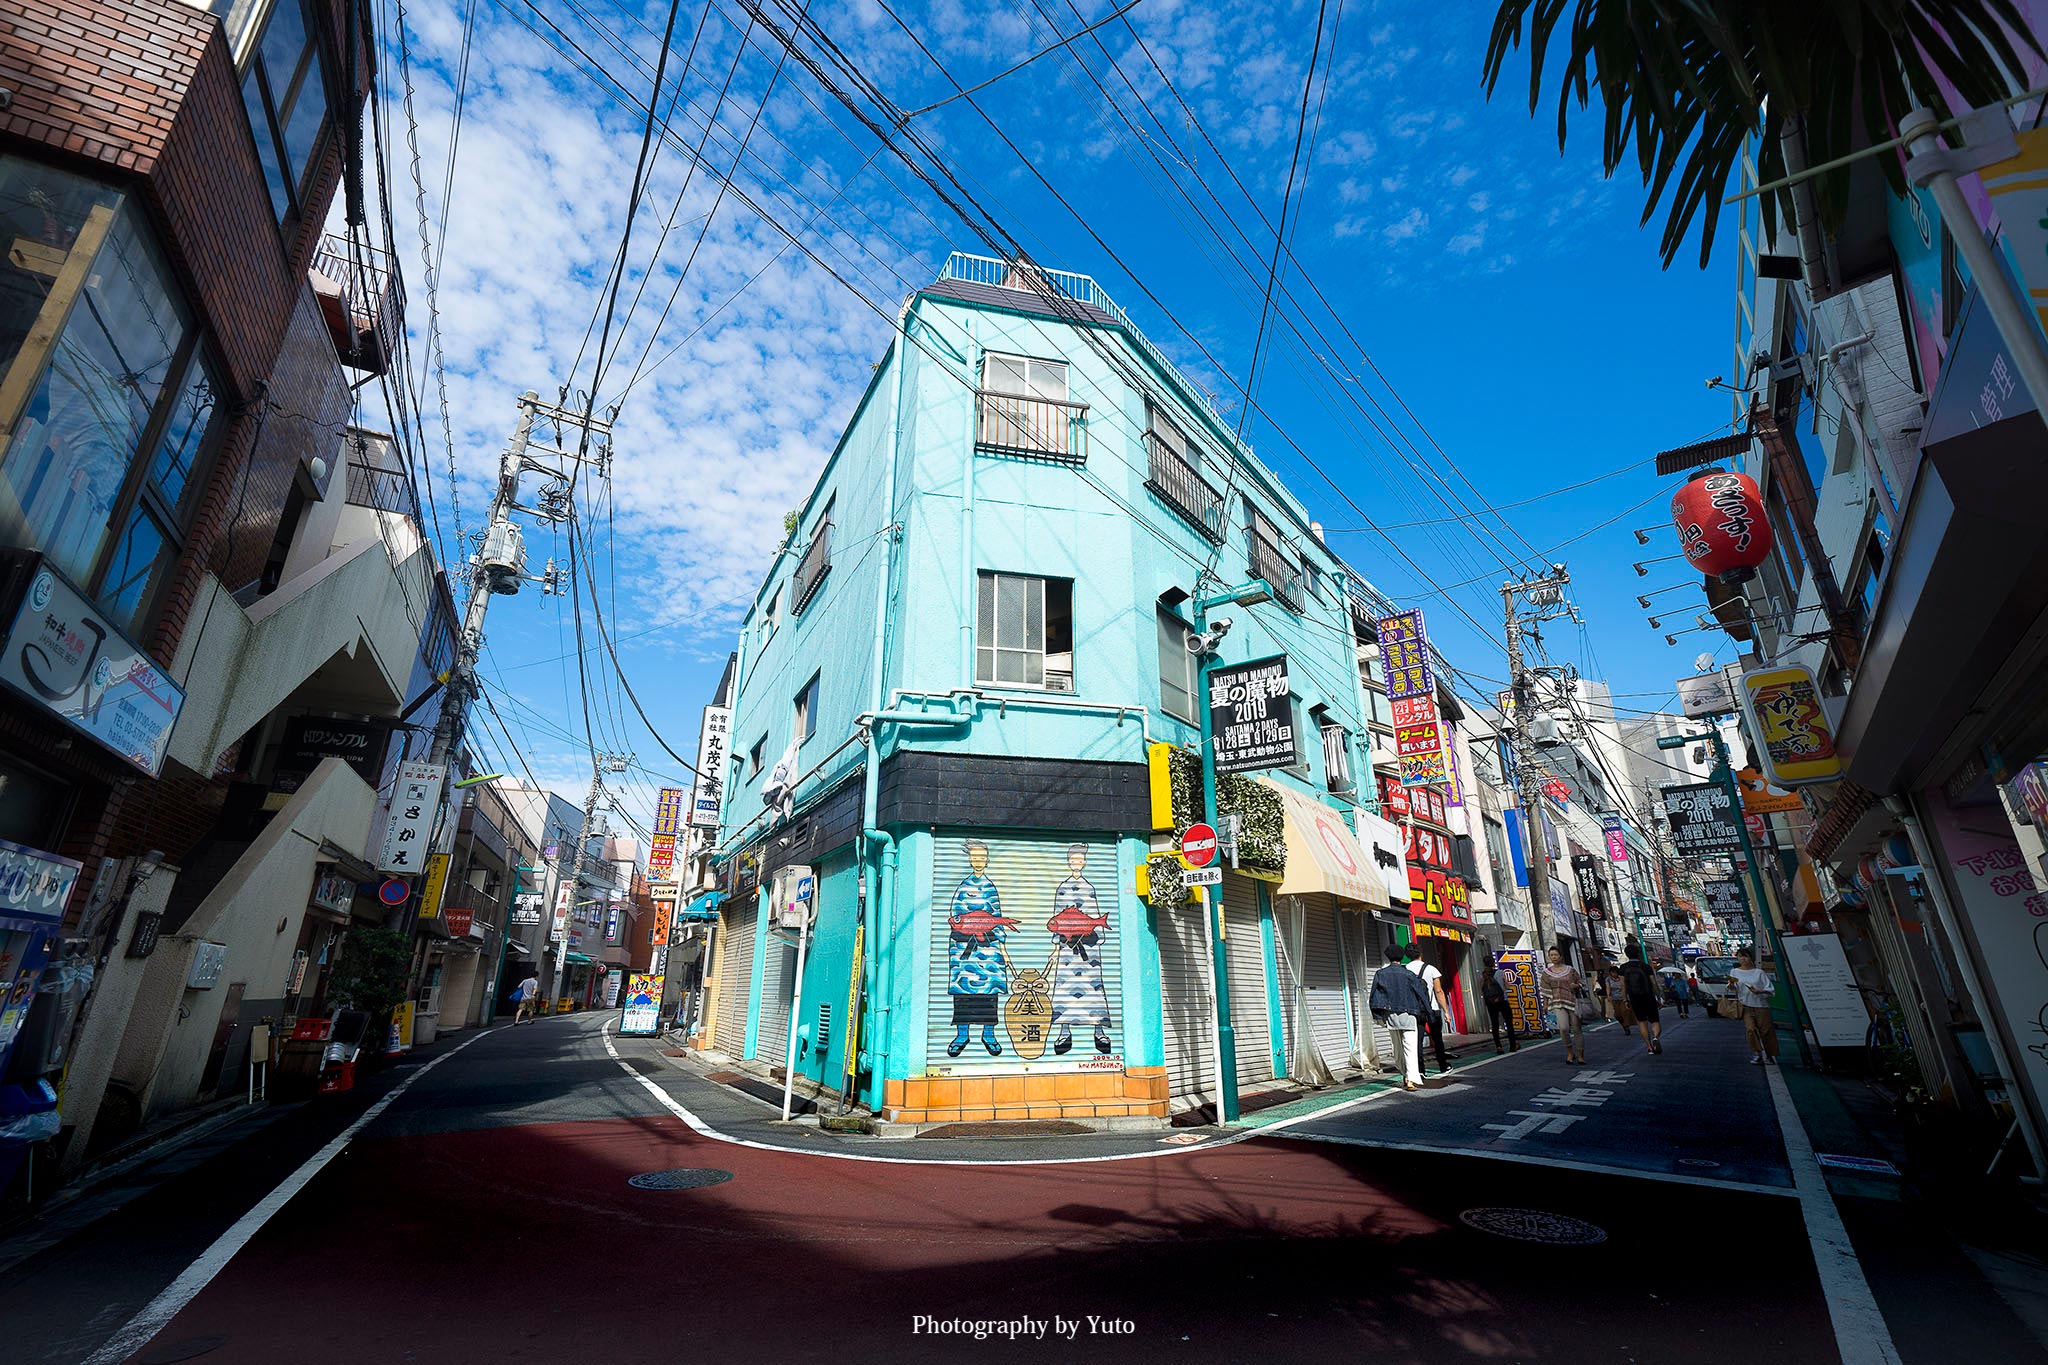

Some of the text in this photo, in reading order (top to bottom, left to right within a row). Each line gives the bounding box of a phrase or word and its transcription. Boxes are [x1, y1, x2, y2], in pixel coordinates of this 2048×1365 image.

[1213, 664, 1282, 687] NATSU NO MAMONO
[1209, 675, 1289, 709] 夏の魔物
[1235, 700, 1267, 723] 2019
[1396, 711, 1434, 725] レンタル
[709, 713, 719, 732] 会社
[719, 714, 728, 733] 有限
[1225, 718, 1279, 737] SAITAMA 2 DAYS
[1399, 726, 1436, 742] ゲーム
[1400, 738, 1438, 753] 買います
[703, 735, 723, 797] 丸茂工業
[1216, 755, 1294, 771] www.natsunomamono.com
[1410, 788, 1430, 818] 映画
[1666, 791, 1685, 800] NATSU
[1695, 787, 1722, 798] MAMONO
[1664, 795, 1730, 813] 夏の魔物
[1687, 808, 1714, 823] 2019
[392, 805, 421, 865] さかえ
[1186, 872, 1219, 884] 自転車を除く
[1020, 998, 1041, 1042] 美酒
